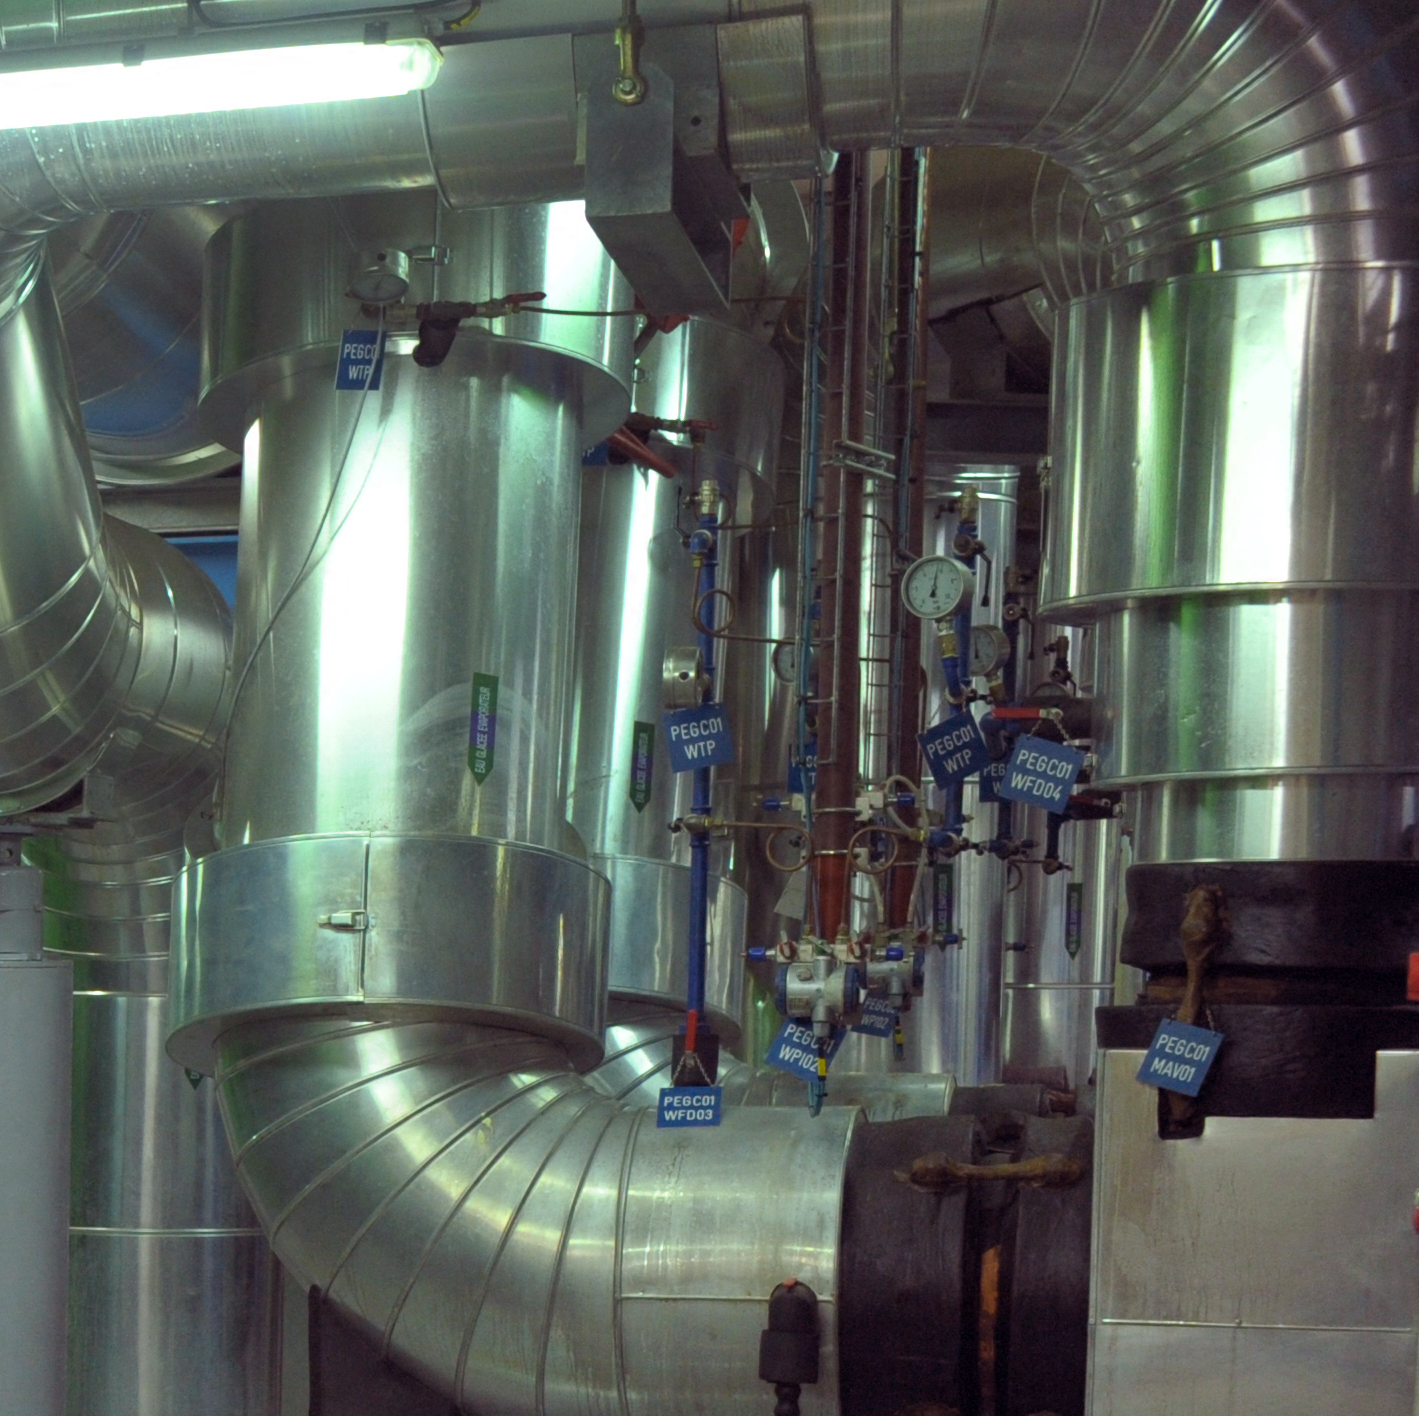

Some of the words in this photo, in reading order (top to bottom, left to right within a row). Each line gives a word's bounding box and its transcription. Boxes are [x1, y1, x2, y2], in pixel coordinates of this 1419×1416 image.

[343, 343, 380, 360] PEGC0
[670, 716, 723, 742] PEGC01
[683, 740, 716, 761] WTP
[926, 724, 976, 760] PEGC01
[942, 749, 973, 774] WTP
[983, 762, 1007, 777] PEG
[1016, 750, 1073, 780] PEGC01
[1010, 771, 1063, 801] WFD04
[1156, 1033, 1211, 1062] PEGC01
[1150, 1056, 1196, 1083] MAV01
[663, 1095, 715, 1107] PEGC01
[664, 1109, 713, 1121] WFD03
